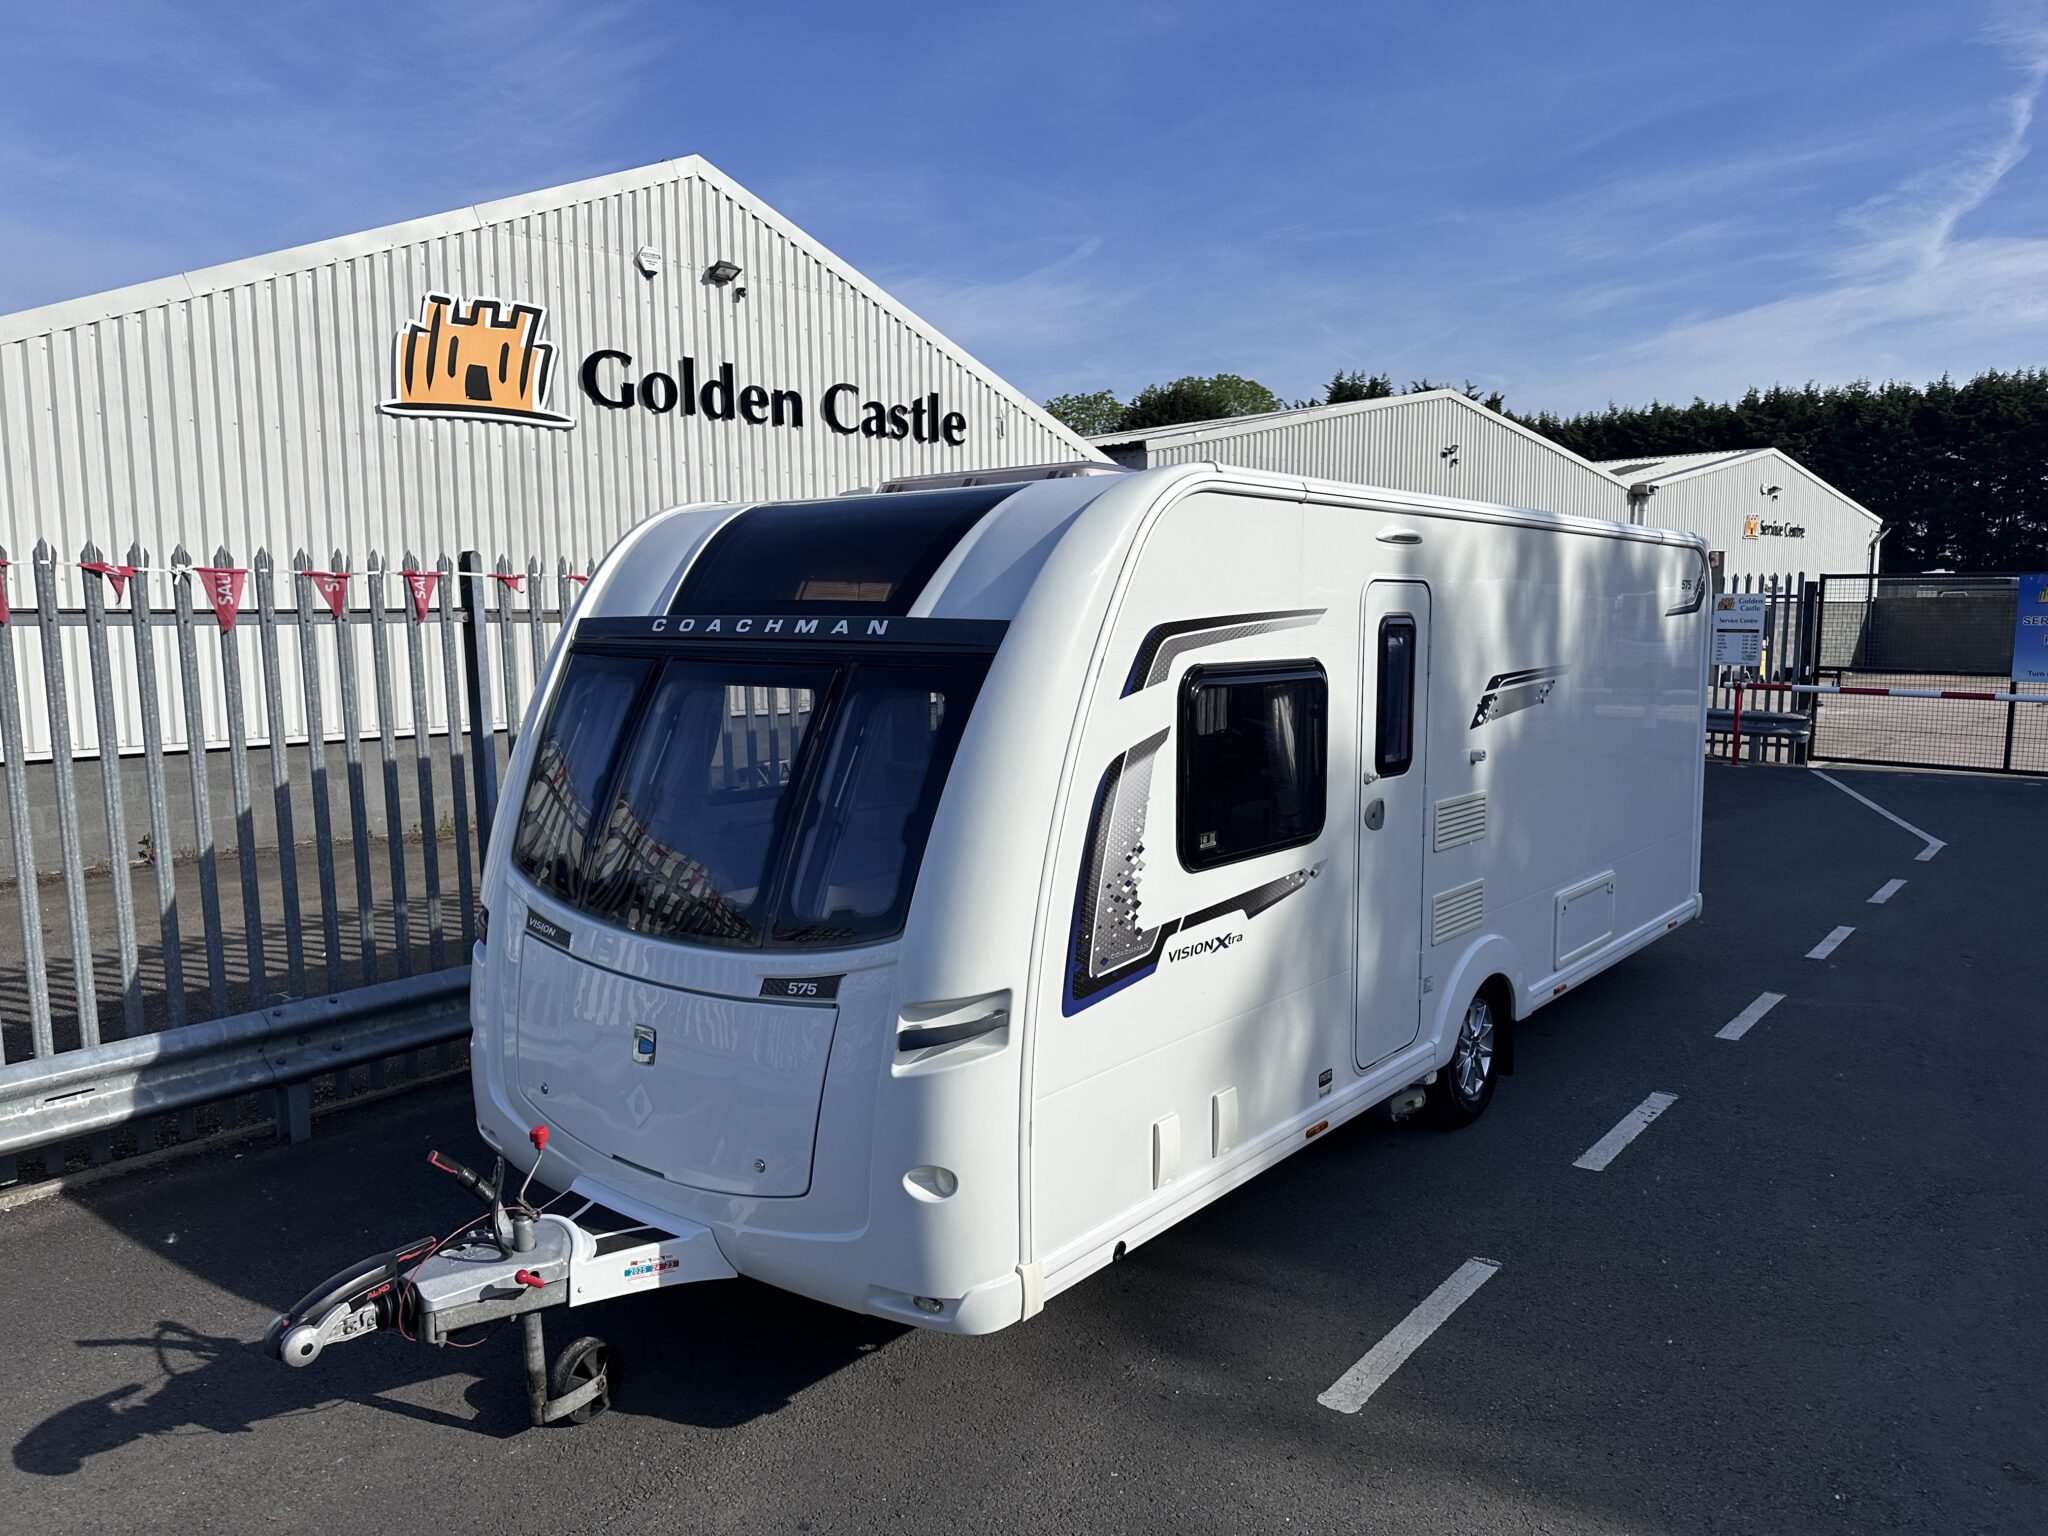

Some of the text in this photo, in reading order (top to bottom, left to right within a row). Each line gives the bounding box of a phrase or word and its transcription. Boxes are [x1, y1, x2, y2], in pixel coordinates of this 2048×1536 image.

[580, 349, 967, 447] Golden Castle
[1681, 579, 1692, 590] 575
[1738, 597, 1764, 605] Golden
[652, 619, 888, 635] COACHMAN
[529, 917, 556, 937] VISION
[787, 982, 817, 996] 575
[629, 1266, 647, 1276] 2025
